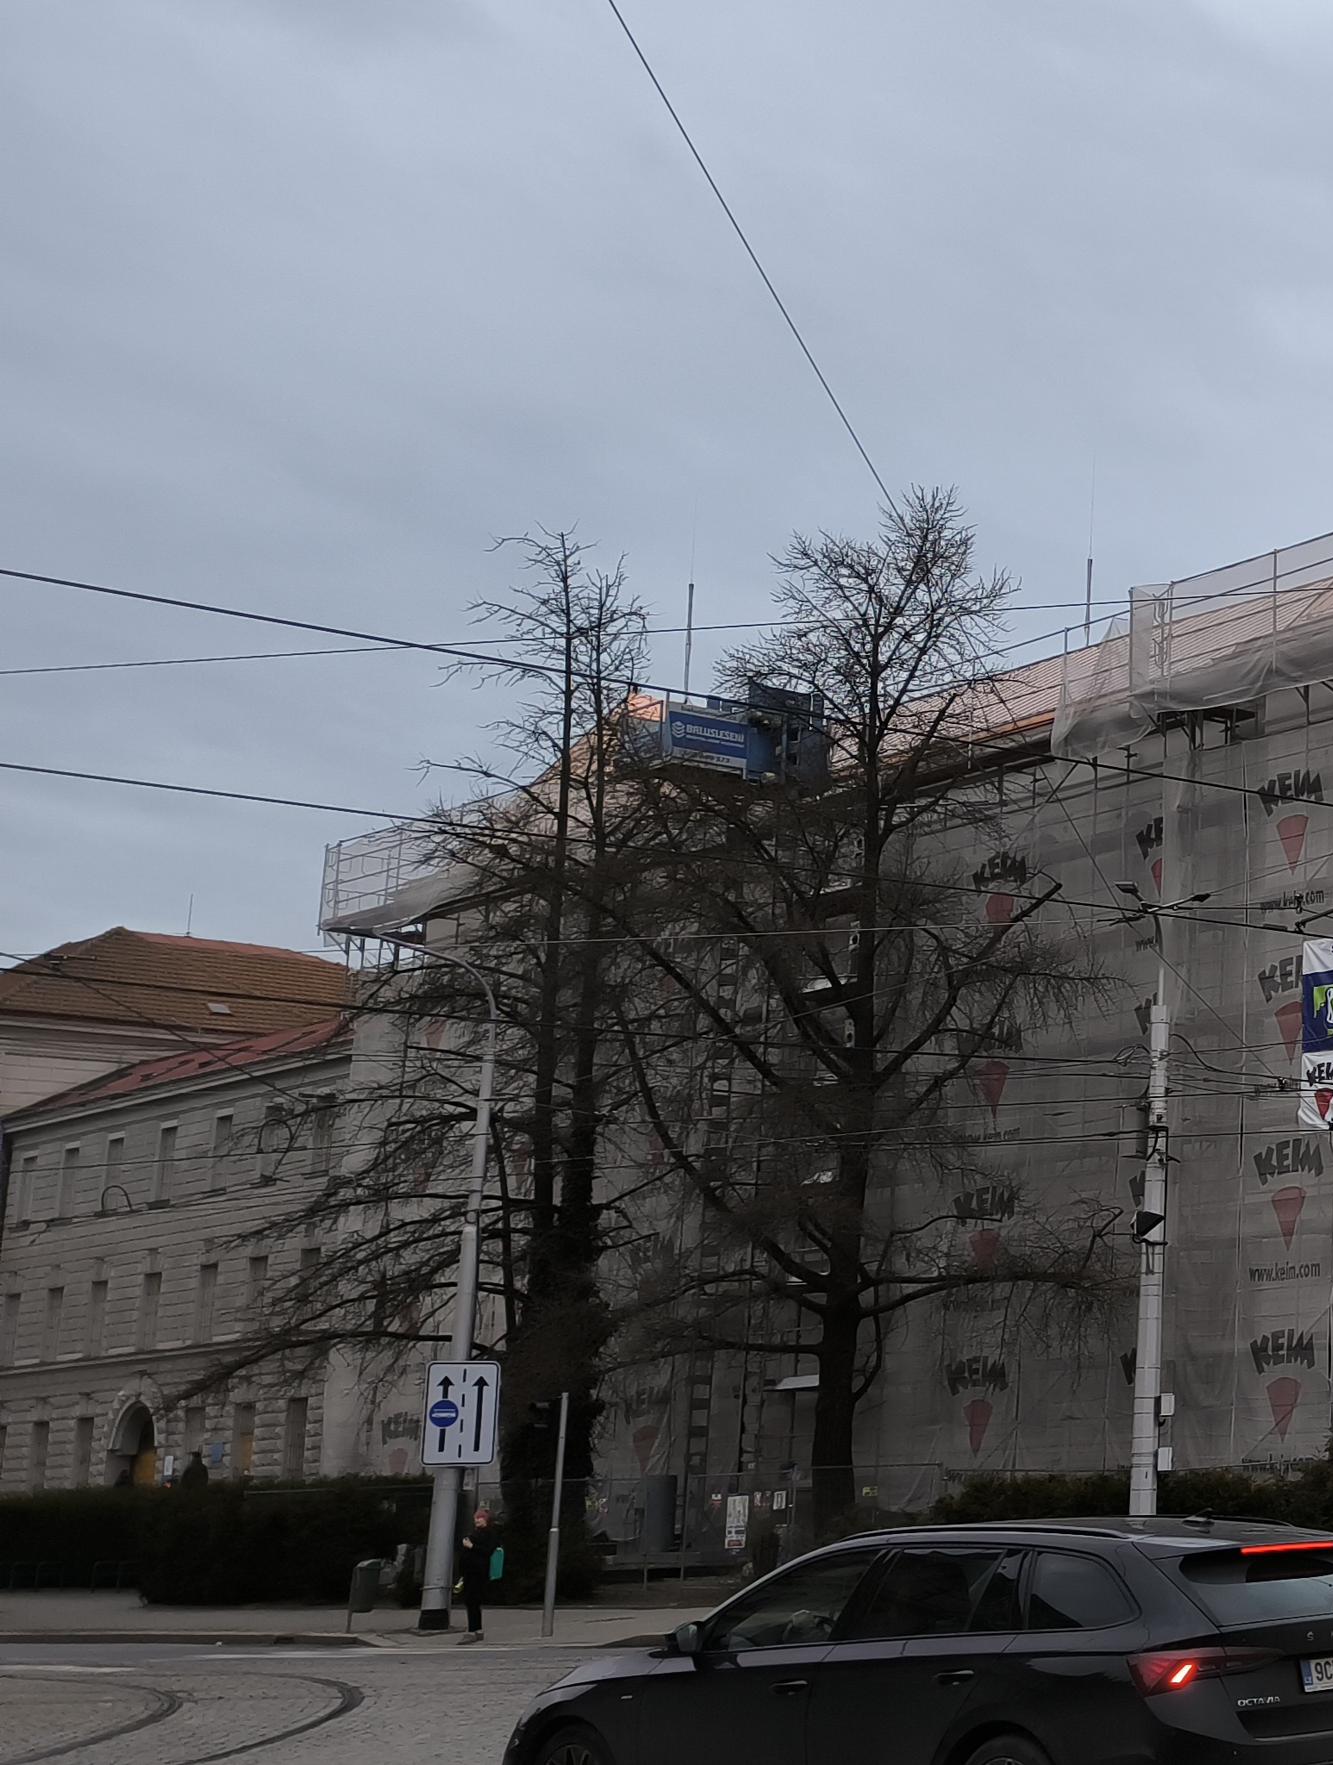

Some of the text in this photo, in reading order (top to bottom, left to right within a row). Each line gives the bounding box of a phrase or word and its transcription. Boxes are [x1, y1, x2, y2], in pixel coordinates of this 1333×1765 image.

[1257, 768, 1324, 817] KEIM
[1253, 1138, 1324, 1186] KEIM
[1249, 1261, 1321, 1283] www.keim.com
[1249, 1328, 1316, 1375] KEIM
[945, 1355, 1007, 1396] KEIM
